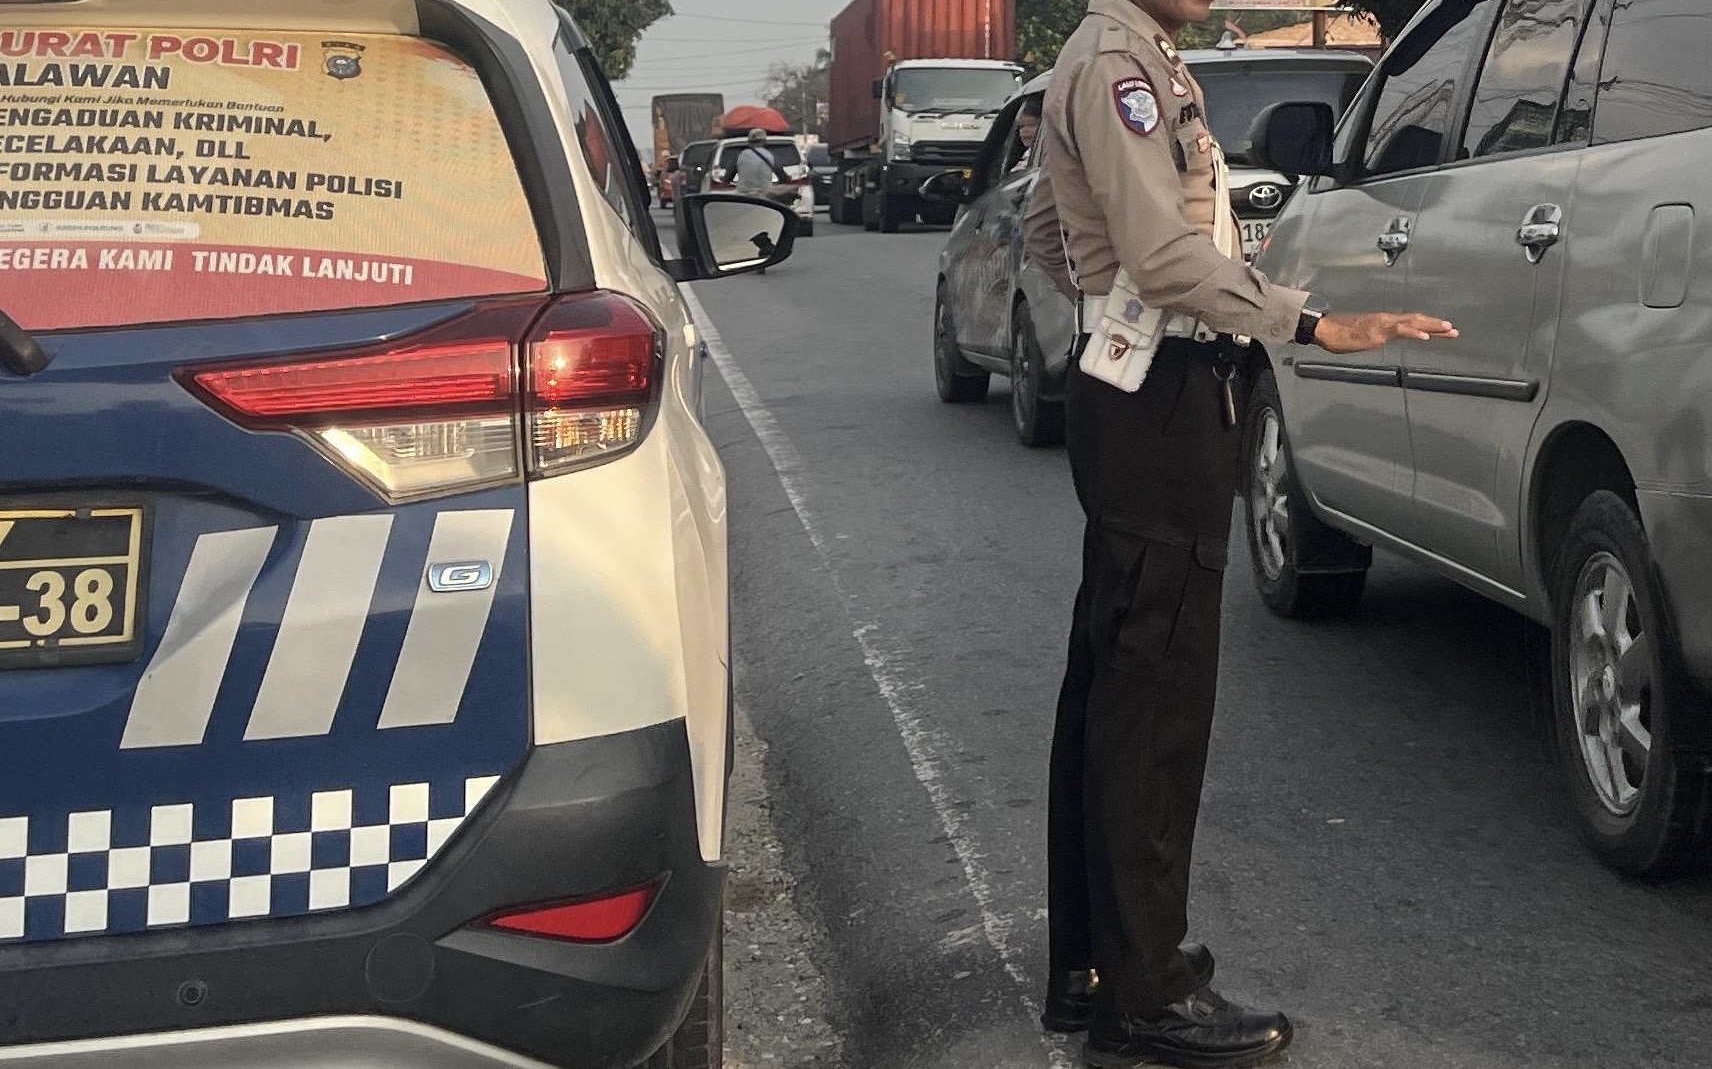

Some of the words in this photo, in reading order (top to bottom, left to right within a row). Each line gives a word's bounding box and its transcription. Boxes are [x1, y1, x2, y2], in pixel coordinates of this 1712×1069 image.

[149, 34, 300, 69] POLRI
[1, 94, 61, 105] Hubungi
[64, 94, 101, 104] Kami
[103, 95, 134, 105] Jika
[173, 111, 333, 143] KRIMINAL,
[195, 138, 251, 160] DLL
[146, 164, 297, 191] LAYANAN
[306, 172, 403, 200] POLISI
[141, 193, 335, 221] KAMTIBMAS
[99, 248, 174, 271] KAMI
[191, 250, 293, 277] TINDAK
[302, 257, 413, 286] LANJUTI
